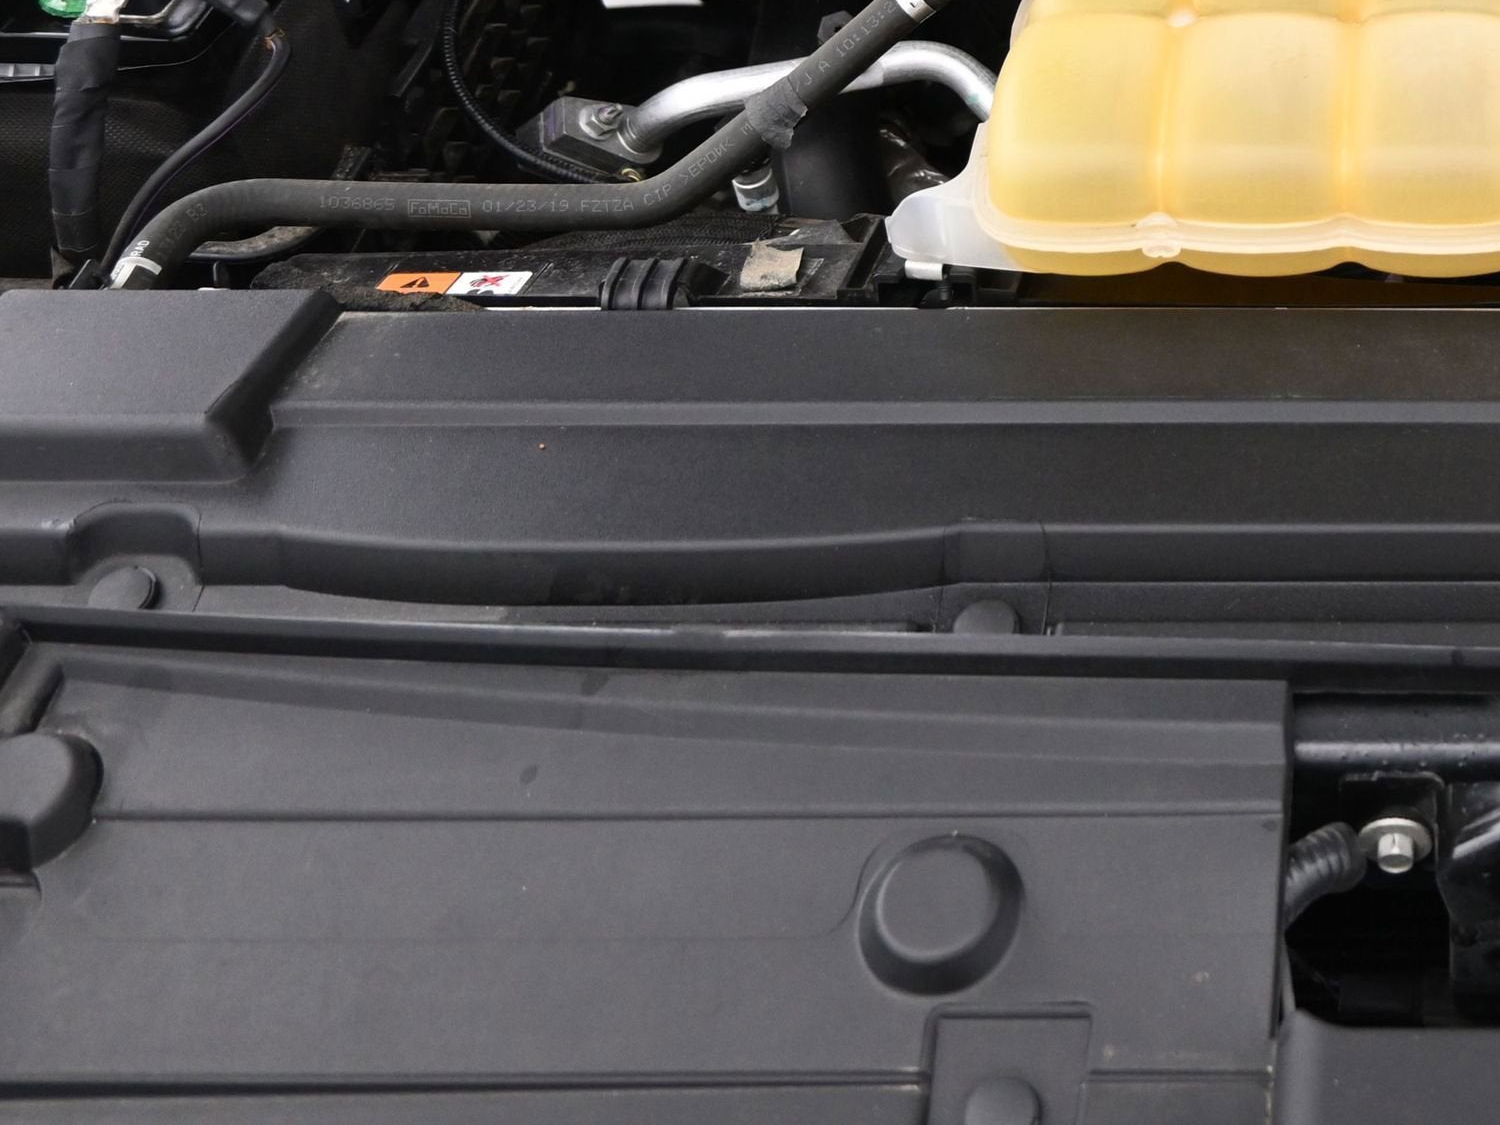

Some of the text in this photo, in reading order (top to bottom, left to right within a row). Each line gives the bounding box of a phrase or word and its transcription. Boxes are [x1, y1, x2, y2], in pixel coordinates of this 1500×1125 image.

[320, 195, 396, 211] 1036865
[482, 199, 569, 213] 01/23/19
[643, 183, 672, 207] CIP
[817, 58, 831, 73] A
[835, 0, 898, 59] 10:13:2
